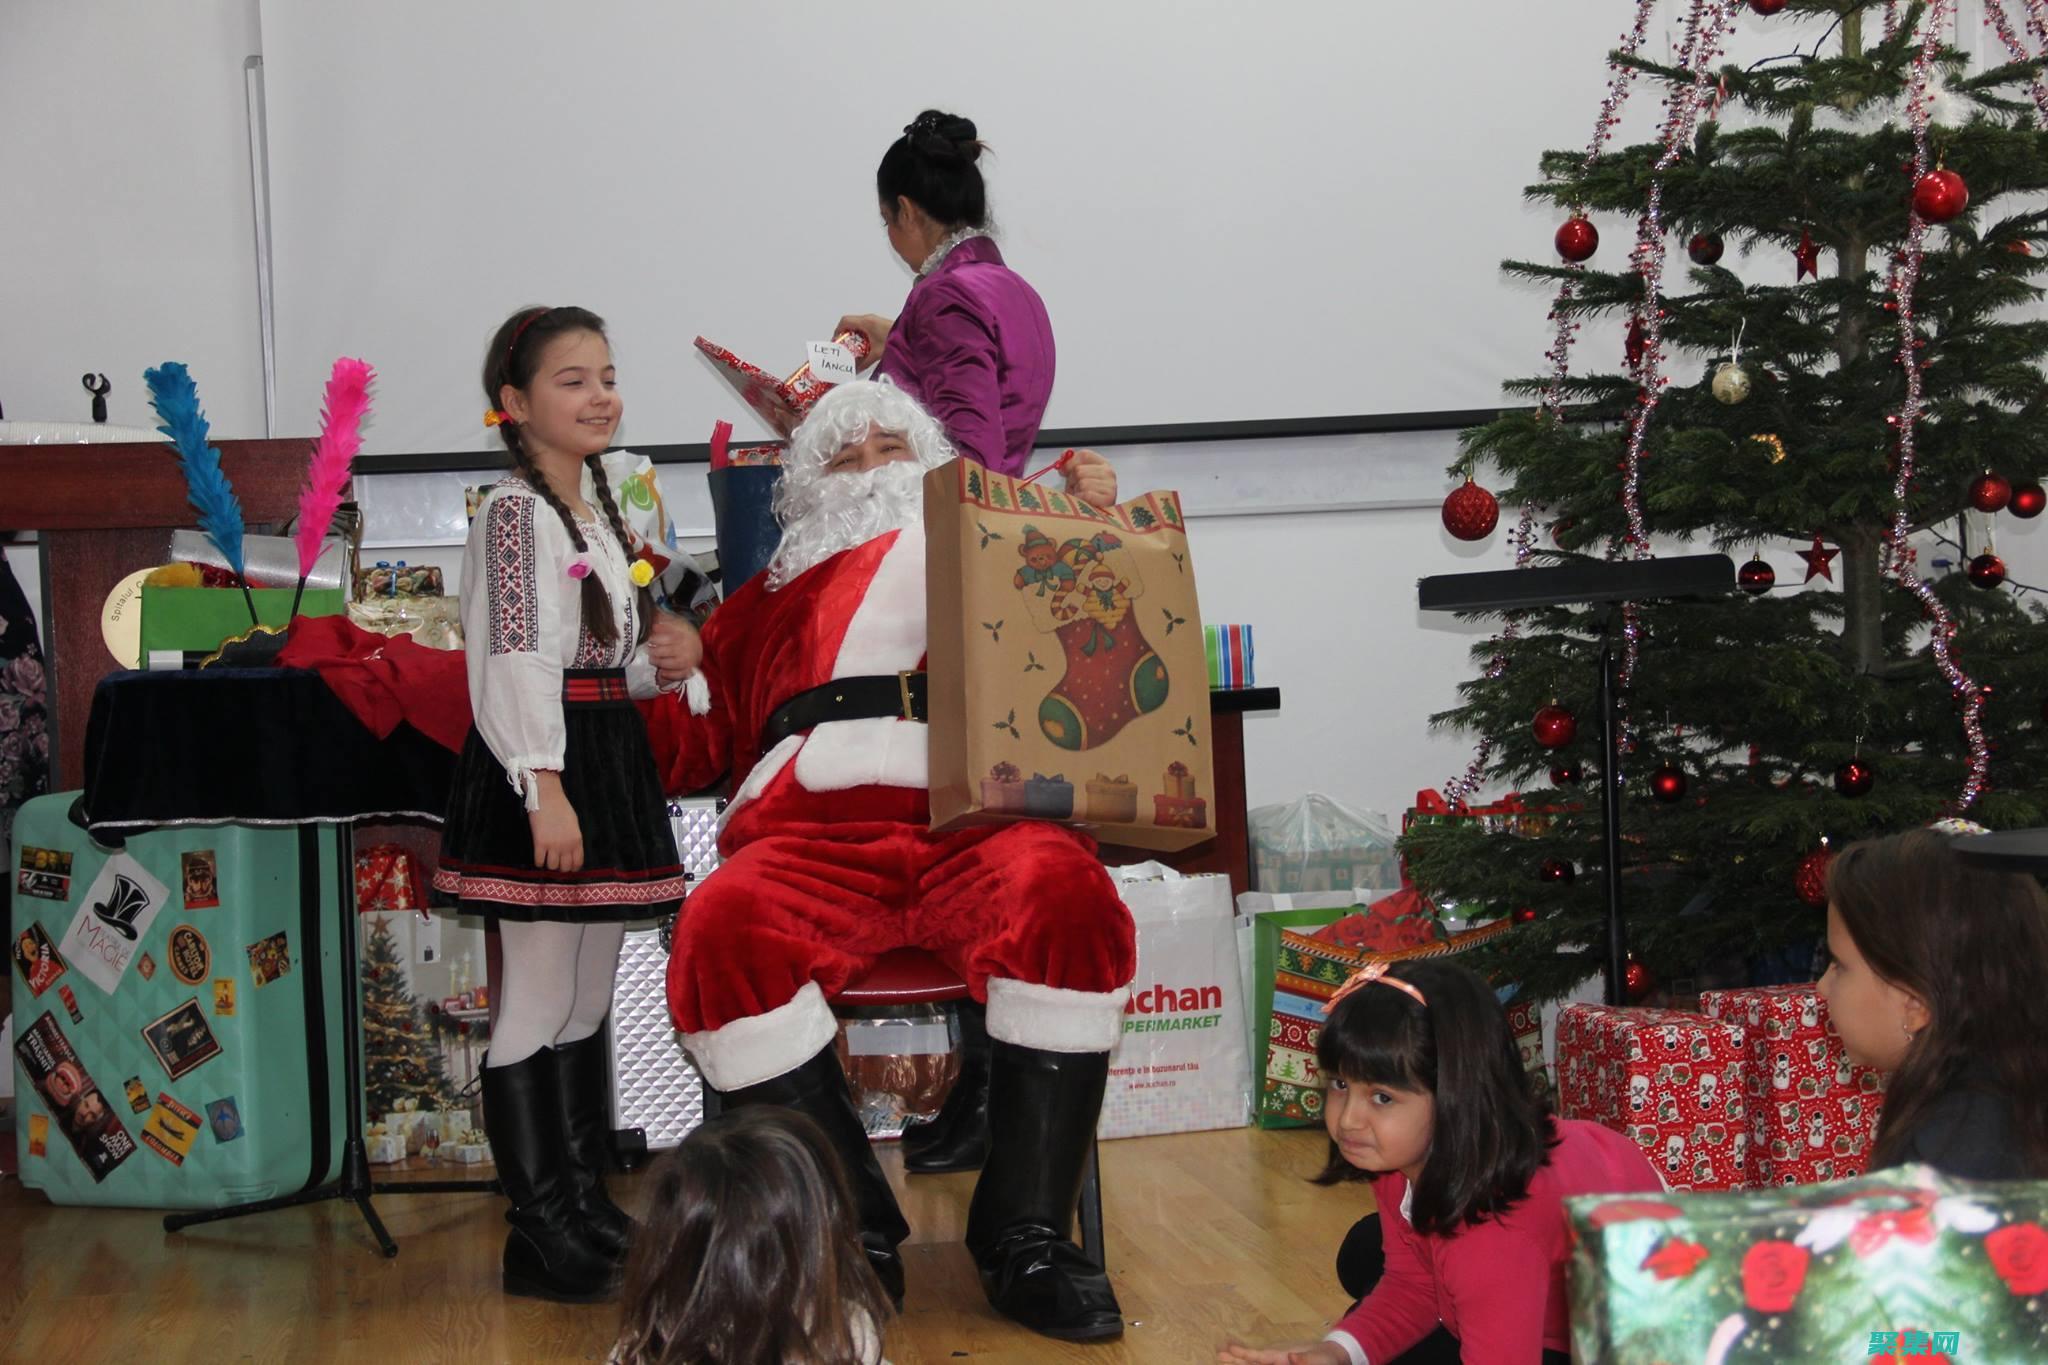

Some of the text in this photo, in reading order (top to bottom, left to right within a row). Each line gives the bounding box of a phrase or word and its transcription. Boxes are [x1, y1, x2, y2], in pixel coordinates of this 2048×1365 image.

[814, 344, 840, 357] LETI
[821, 359, 853, 374] IANCU
[111, 588, 134, 622] Spitalul
[28, 943, 50, 988] VICTORIA
[1124, 984, 1222, 1014] chan
[1121, 1015, 1222, 1034] PERMARKET
[98, 1133, 121, 1160] SHOW
[116, 1130, 133, 1150] ONE
